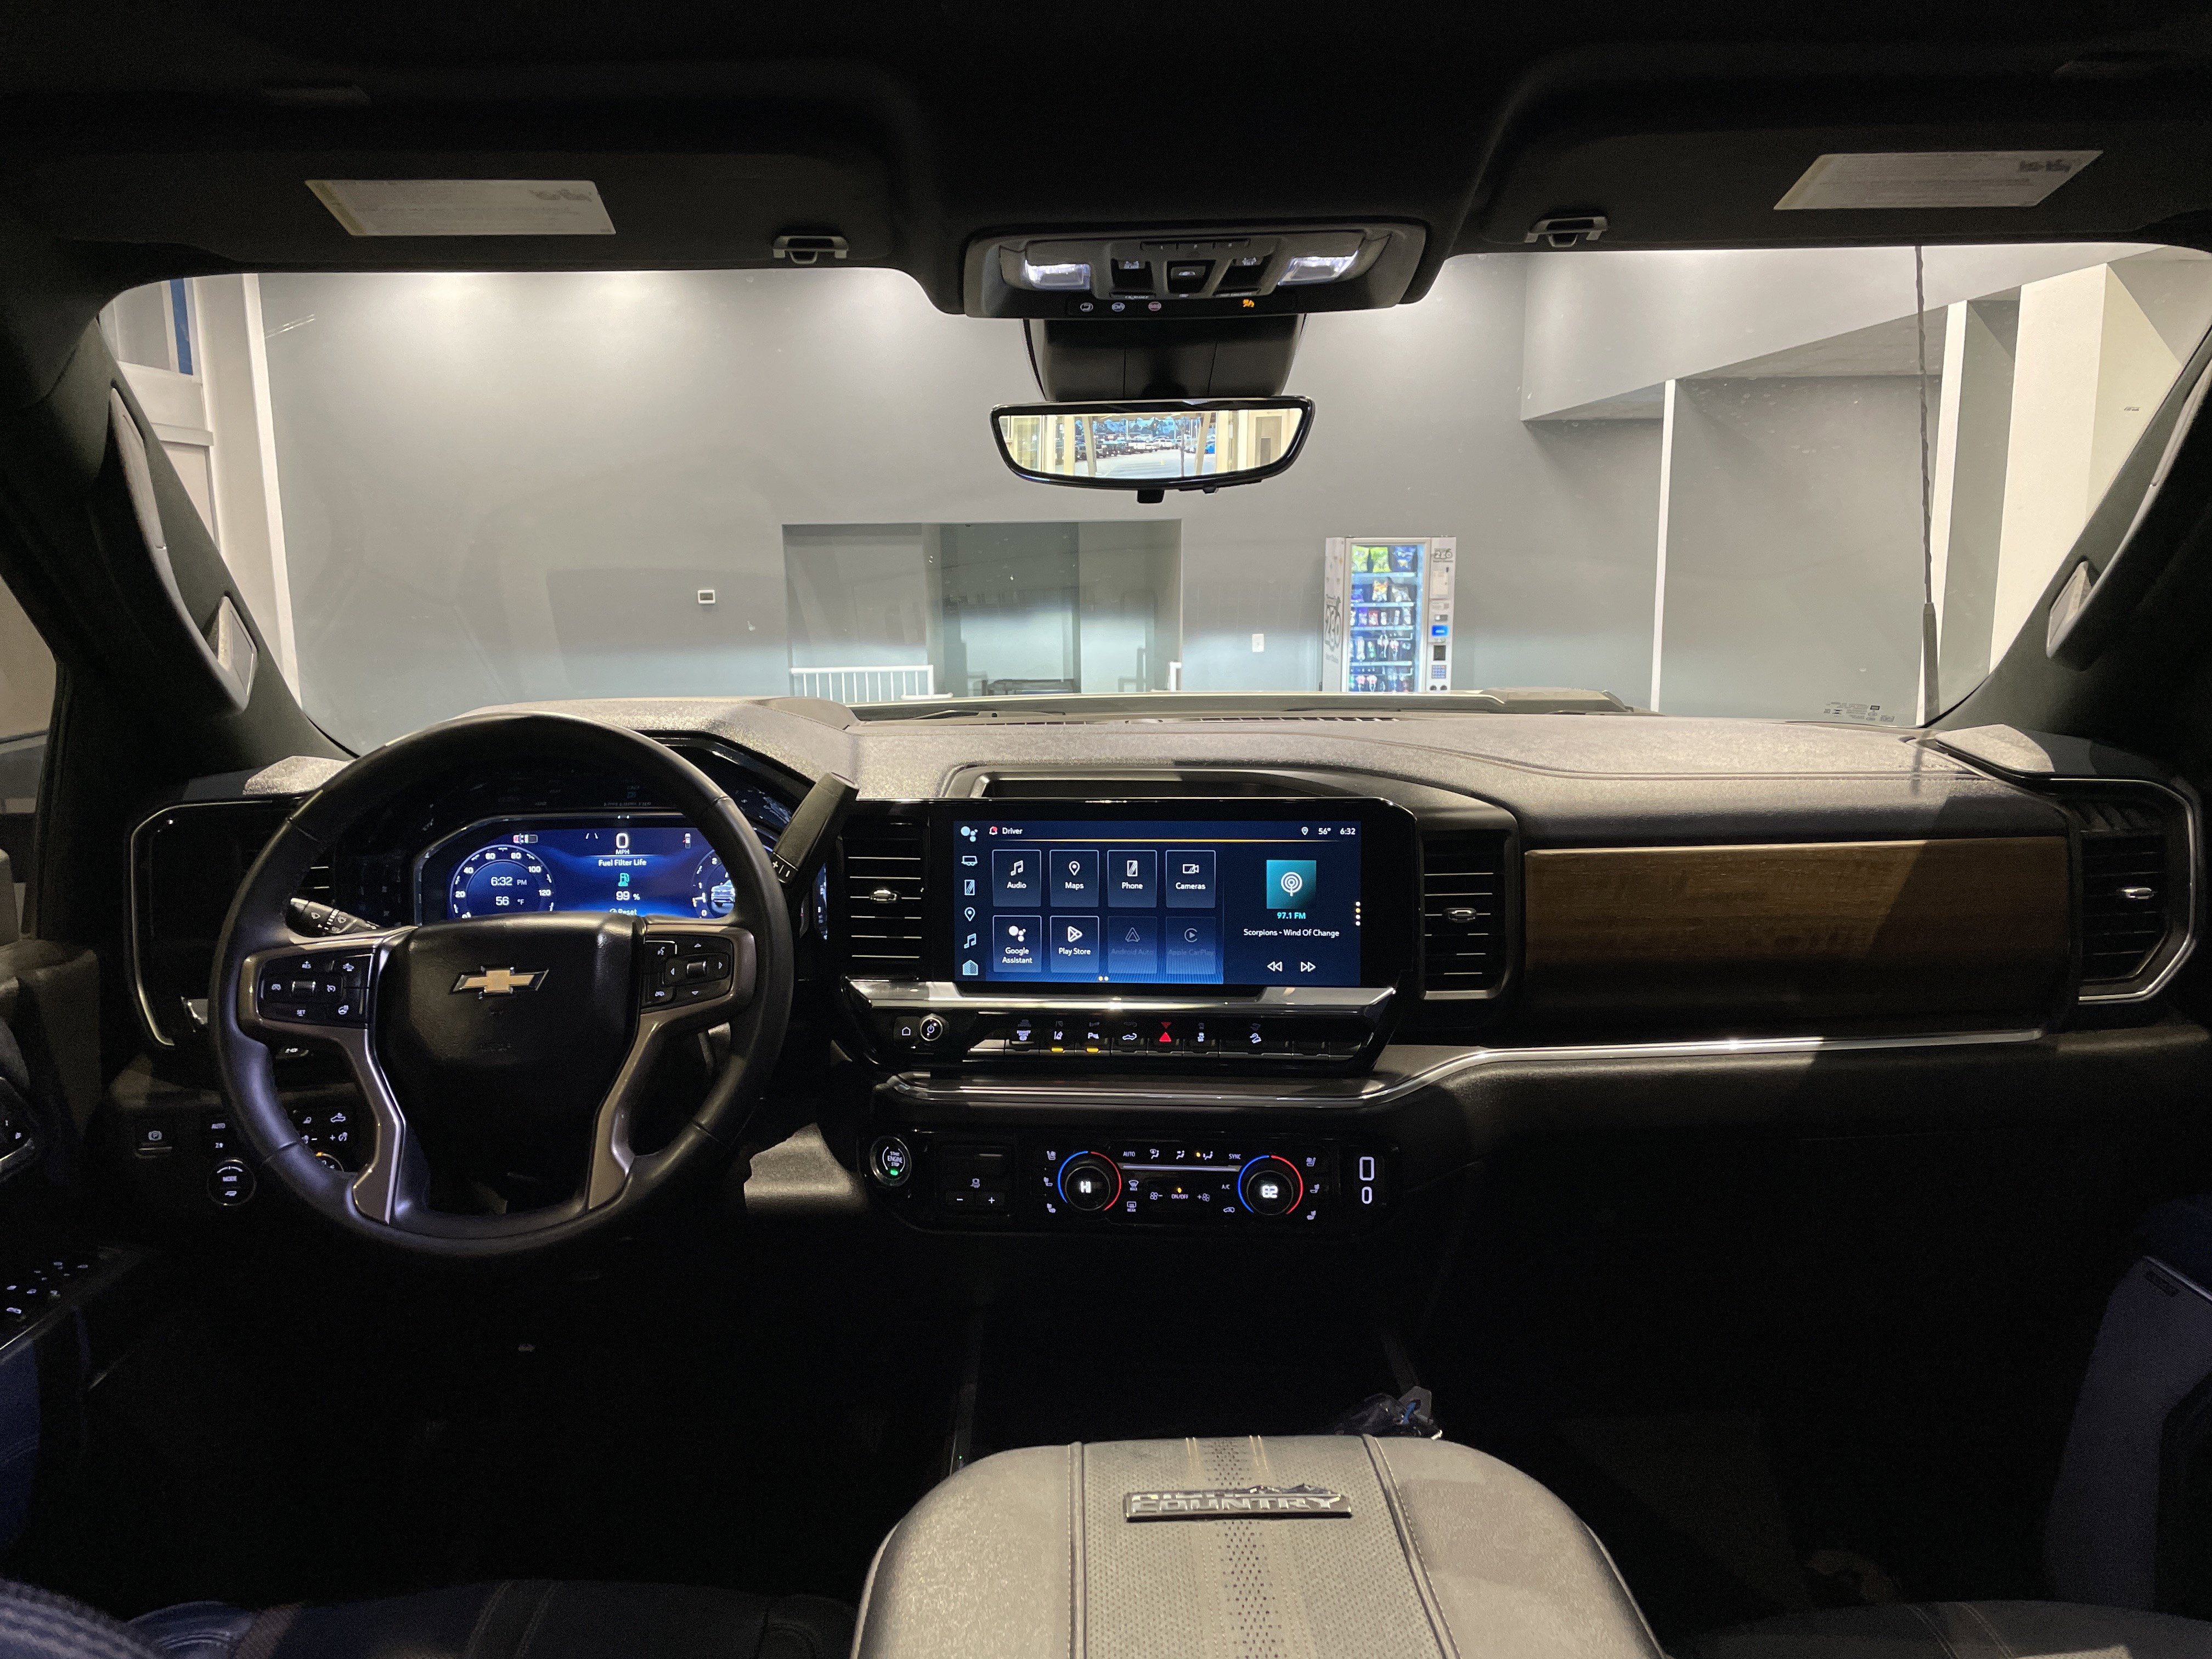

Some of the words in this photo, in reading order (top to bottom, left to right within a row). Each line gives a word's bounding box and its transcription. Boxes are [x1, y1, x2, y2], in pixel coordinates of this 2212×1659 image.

[616, 833, 629, 849] 0
[490, 876, 513, 886] 6:32
[1065, 882, 1084, 890] Maps
[616, 890, 630, 901] 99
[495, 896, 510, 906] 56
[1243, 929, 1278, 937] Scorpions
[1313, 929, 1340, 938] Change
[1005, 947, 1029, 956] Google
[1058, 947, 1072, 956] Play
[1073, 947, 1091, 955] Store
[1080, 1181, 1092, 1194] HI
